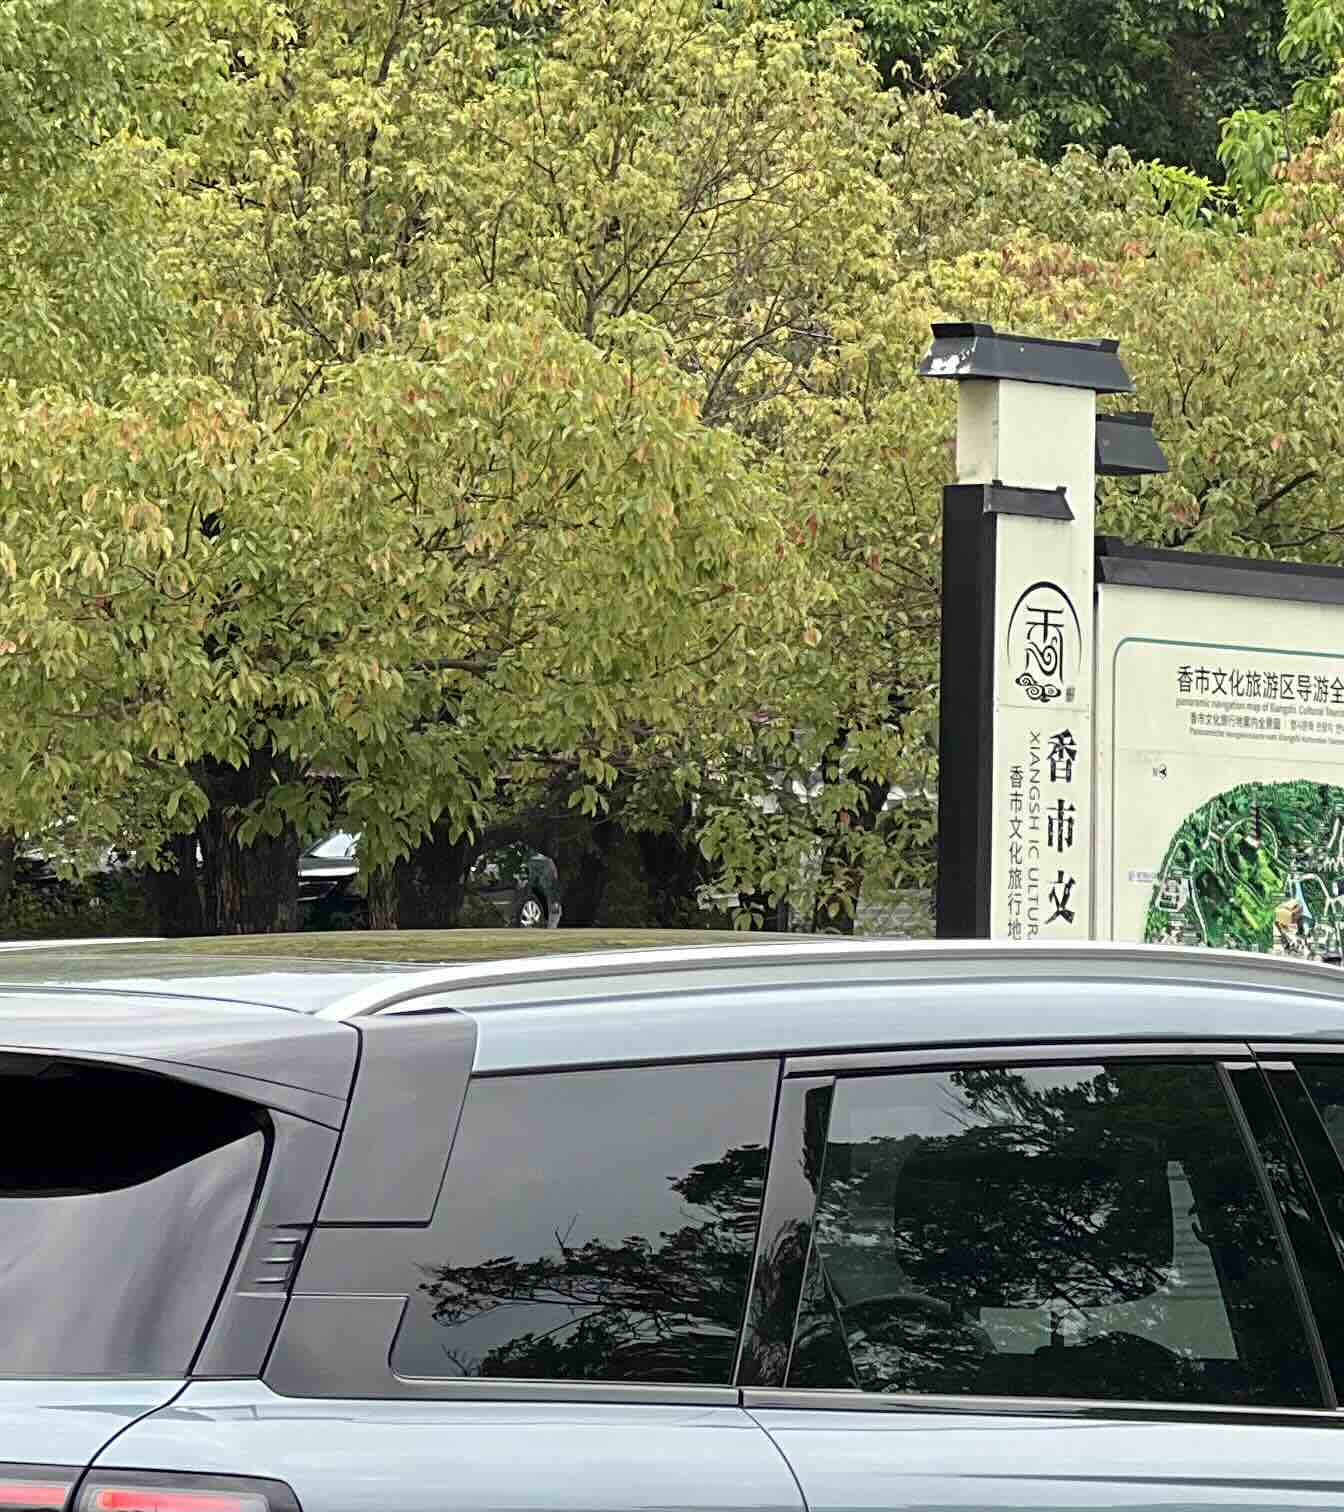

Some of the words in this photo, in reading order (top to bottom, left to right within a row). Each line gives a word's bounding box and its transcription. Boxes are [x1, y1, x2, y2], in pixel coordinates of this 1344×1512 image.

[1007, 765, 1024, 940] 香市文化旅行地
